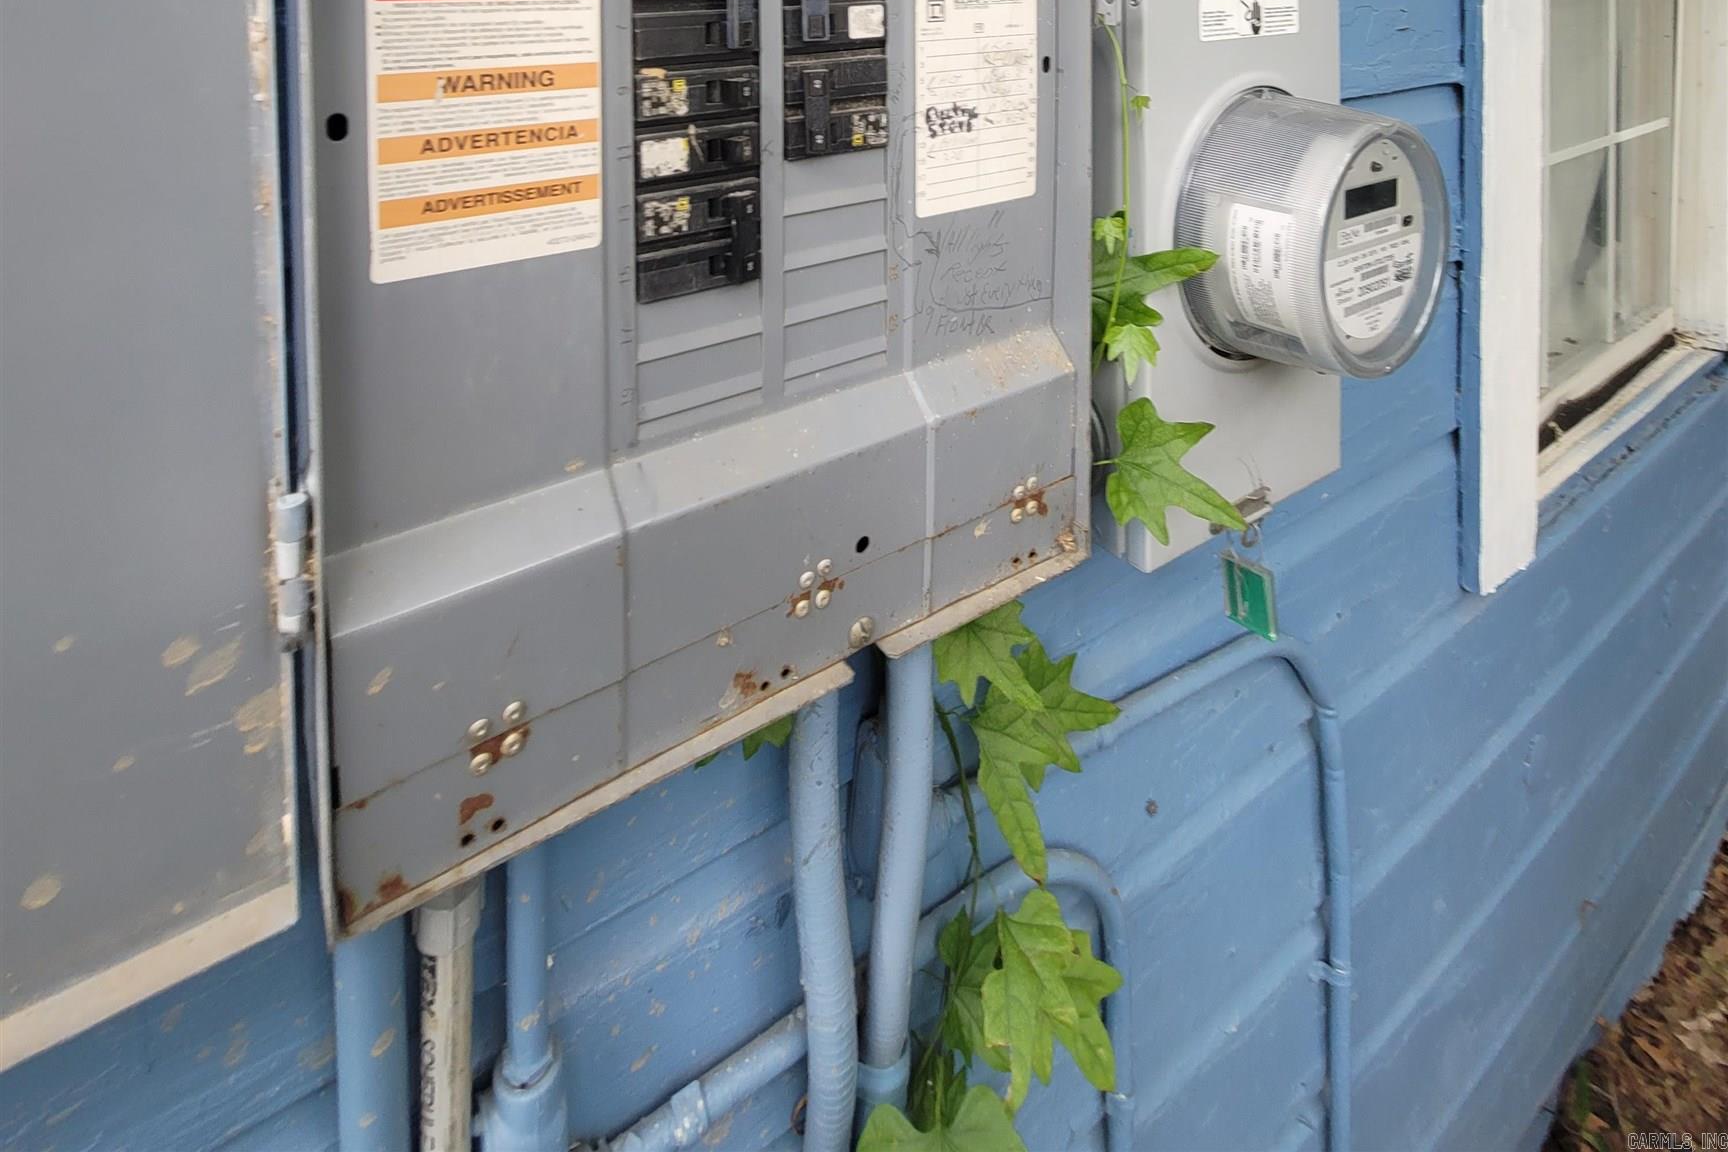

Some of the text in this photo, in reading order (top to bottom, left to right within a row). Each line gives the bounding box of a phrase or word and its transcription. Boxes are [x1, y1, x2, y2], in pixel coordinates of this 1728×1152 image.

[437, 69, 555, 95] WARNING
[420, 124, 579, 155] ADVERTENCIA
[421, 180, 583, 216] ADVERTISSEMENT
